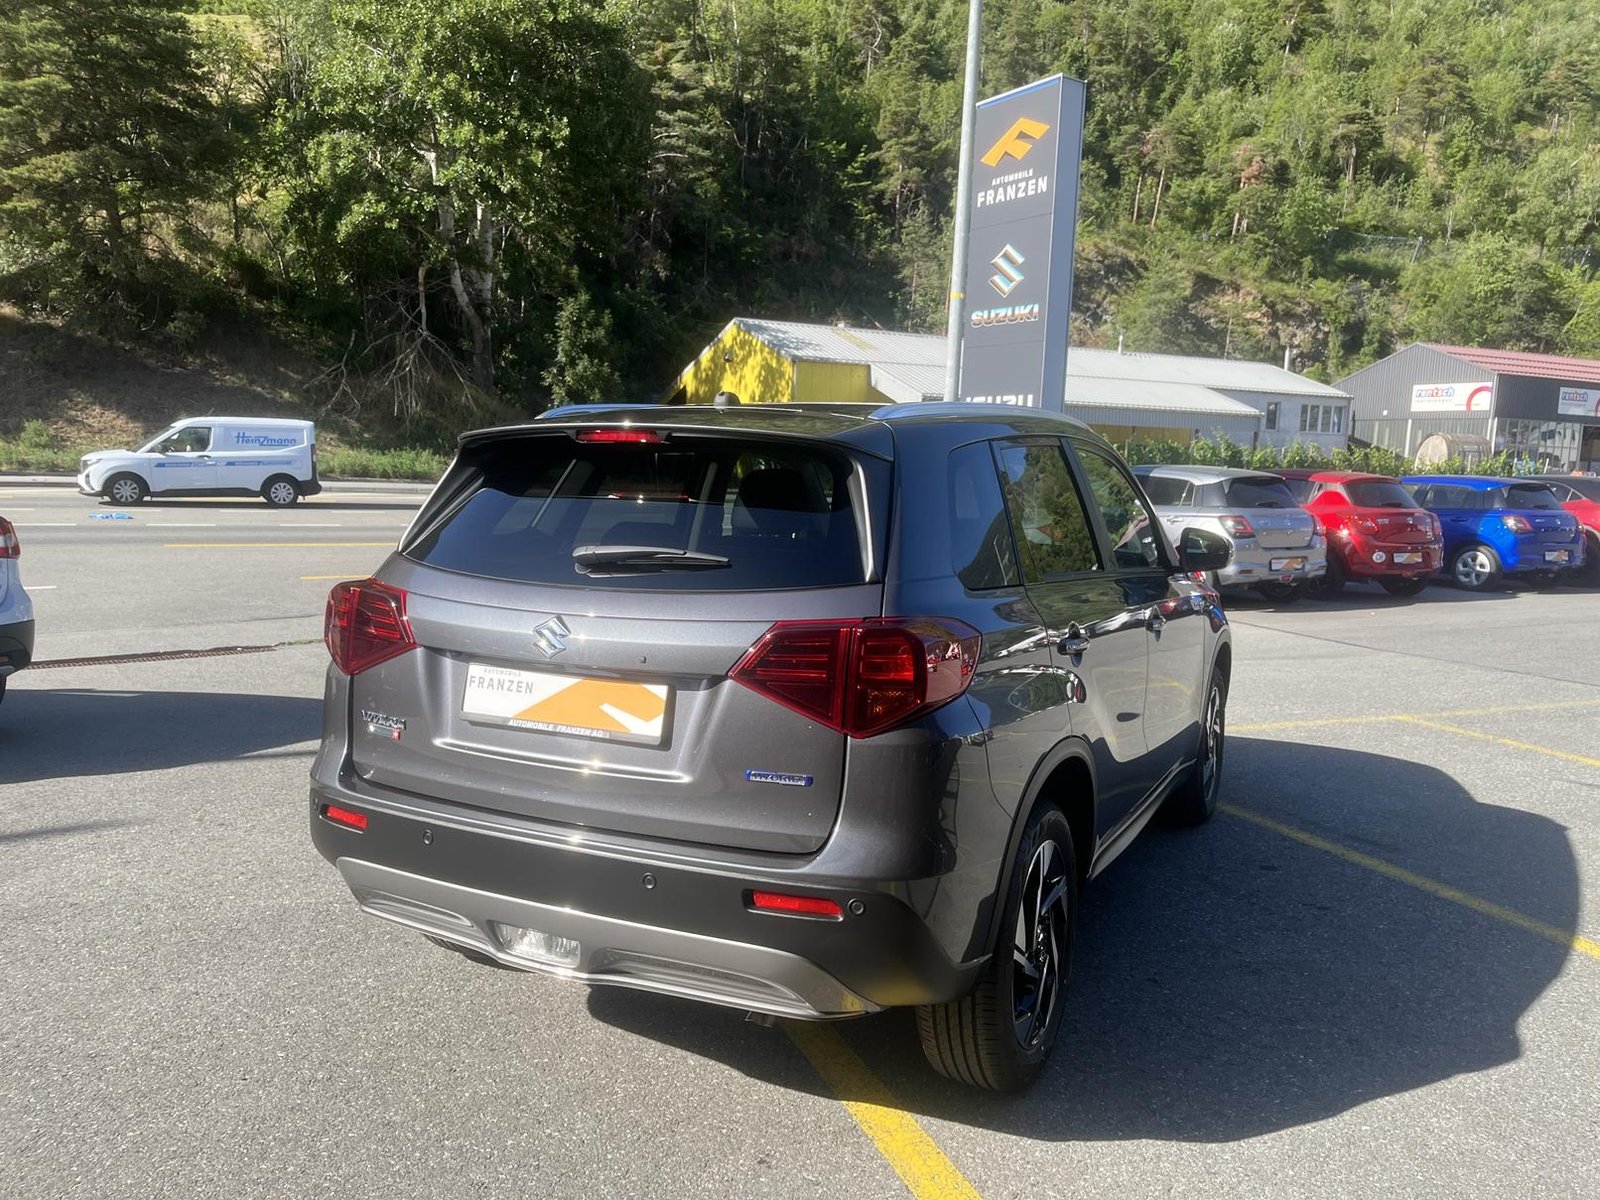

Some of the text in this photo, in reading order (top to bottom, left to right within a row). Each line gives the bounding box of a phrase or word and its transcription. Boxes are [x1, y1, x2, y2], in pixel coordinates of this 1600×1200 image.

[991, 168, 1033, 186] AUTOMOBILE
[977, 176, 1047, 207] FRANZEN
[970, 303, 1040, 328] SUZUKI
[469, 674, 534, 694] FRANZEN
[508, 719, 555, 730] AUTOMOBILE
